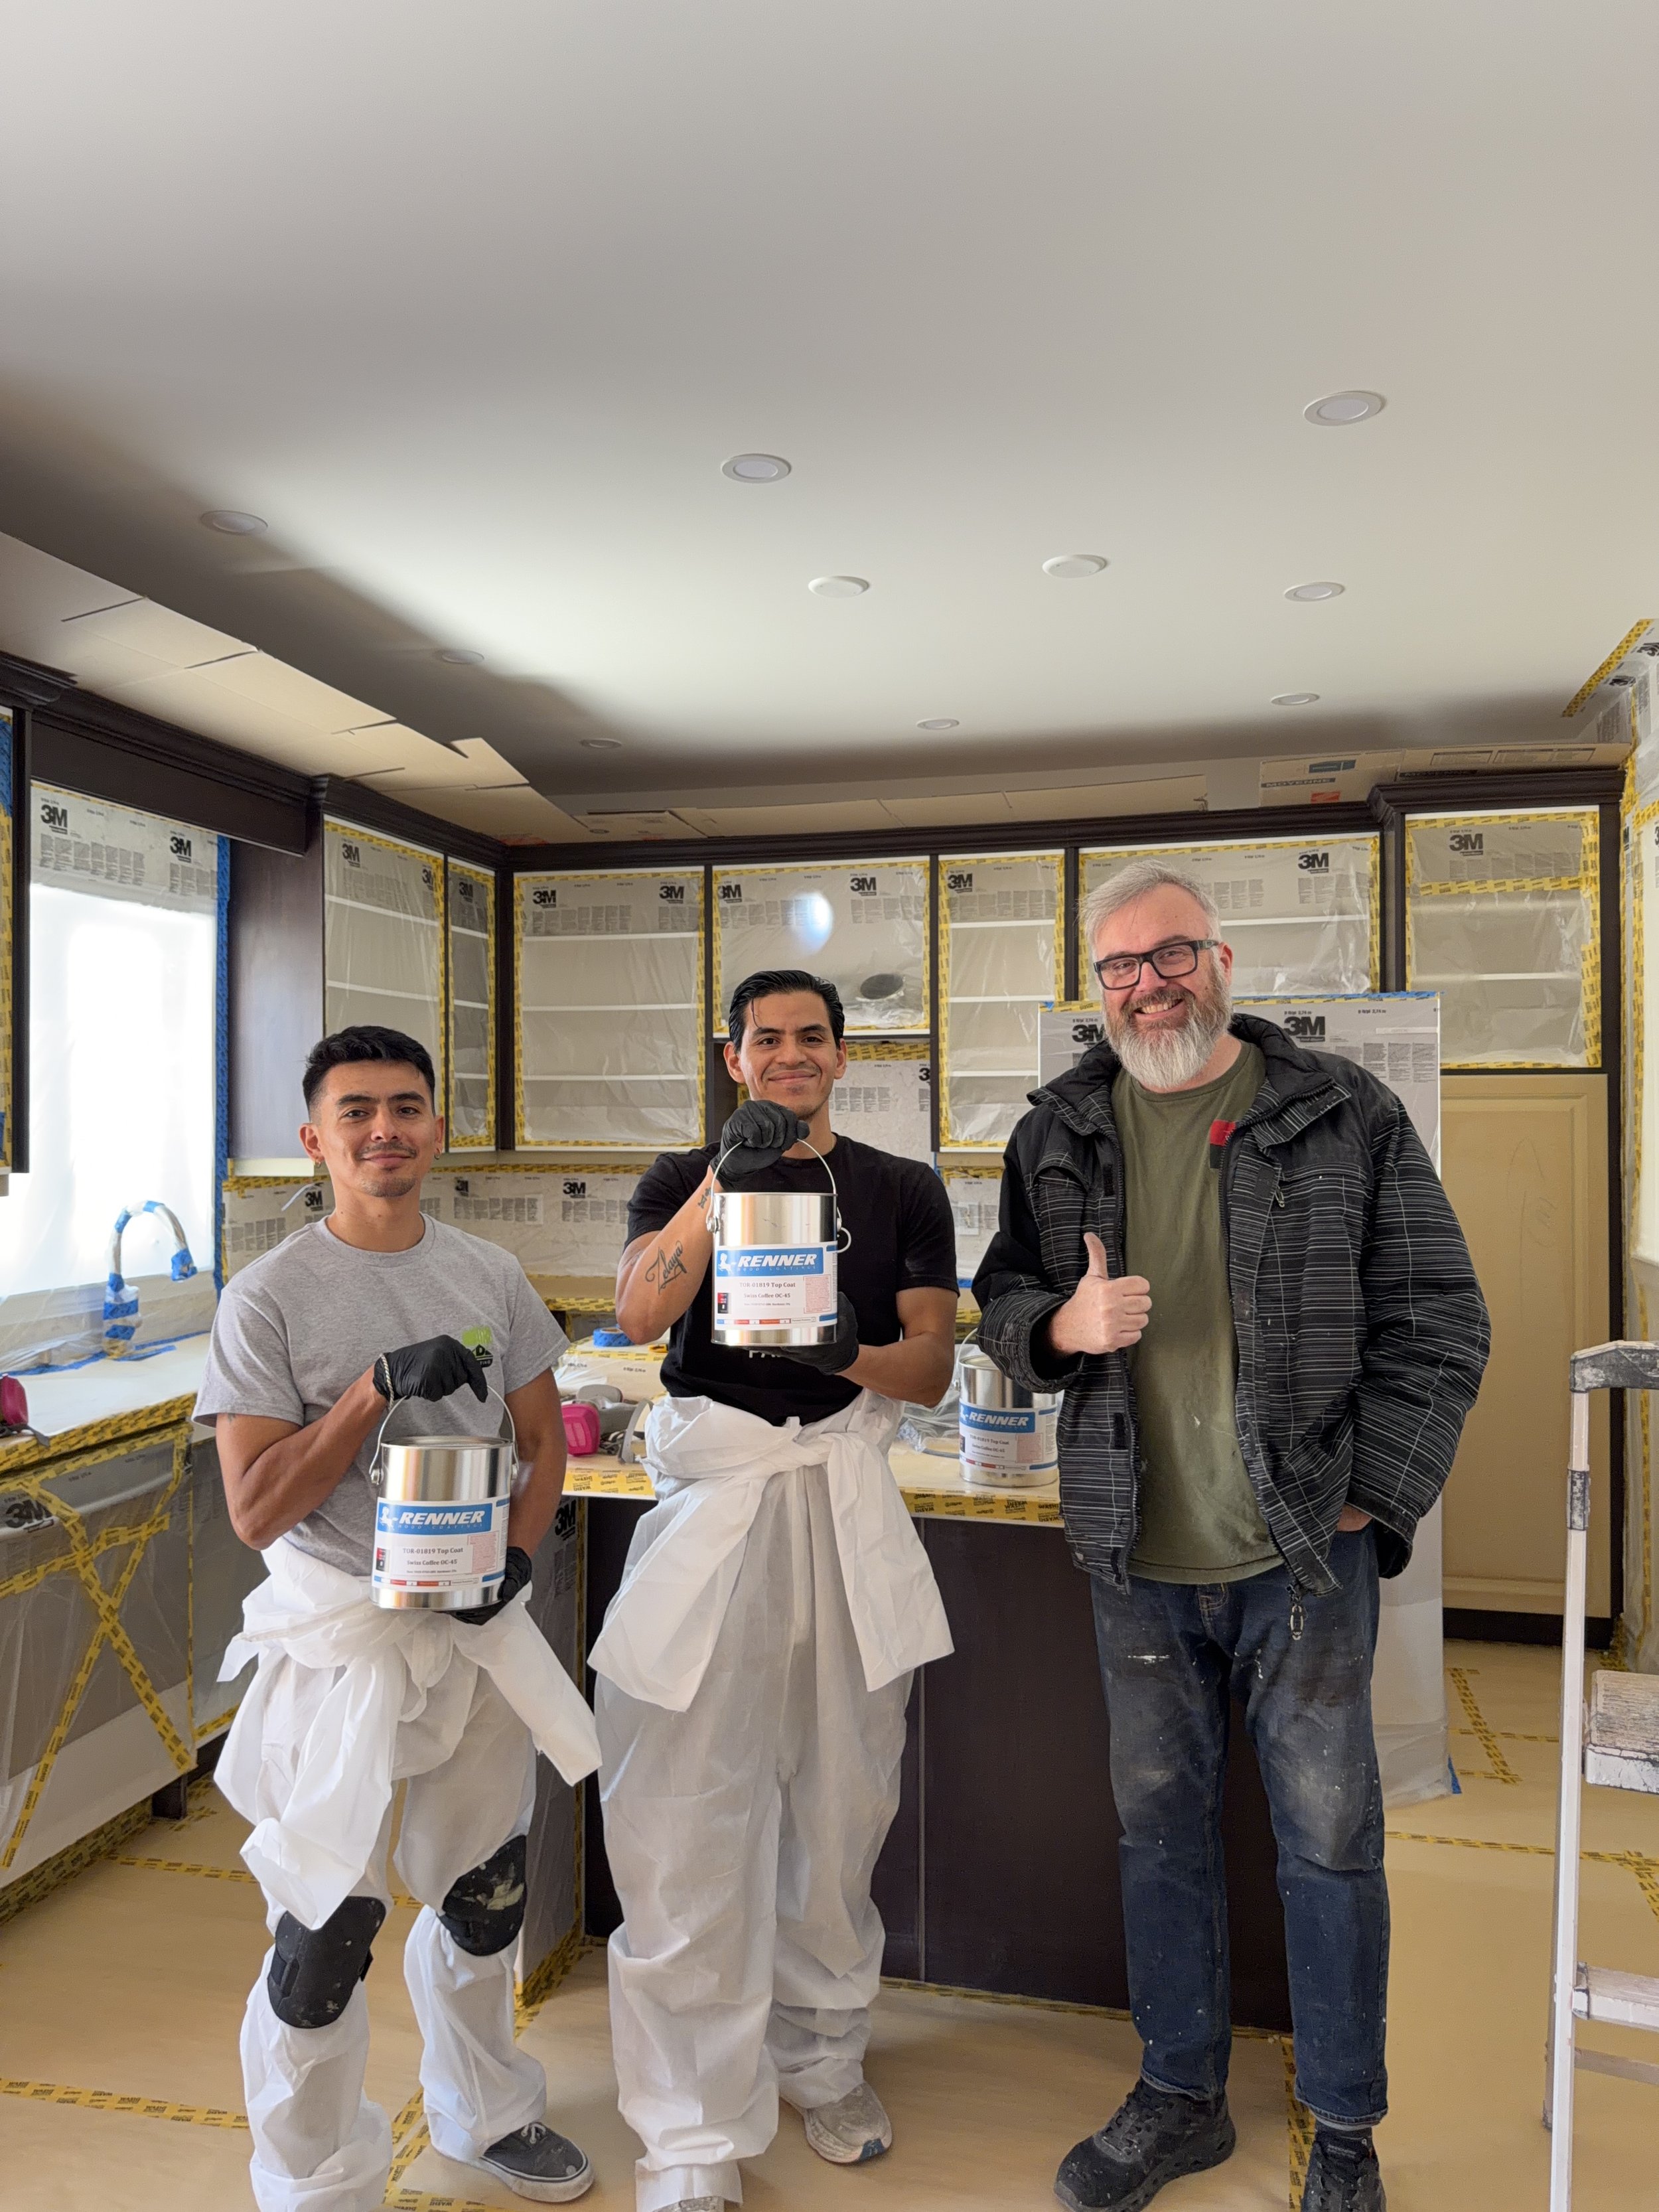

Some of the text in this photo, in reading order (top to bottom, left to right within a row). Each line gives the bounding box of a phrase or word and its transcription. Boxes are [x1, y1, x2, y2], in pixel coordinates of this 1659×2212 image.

[40, 804, 68, 828] 3M
[169, 836, 192, 857] 3M
[1449, 833, 1483, 851] 3M
[342, 844, 360, 862] 3M
[1298, 853, 1329, 869] 3M
[850, 877, 877, 893] 3M
[948, 873, 973, 889] 3M
[533, 889, 556, 905] 3M
[659, 885, 684, 900] 3M
[1283, 1016, 1326, 1035] 3M
[563, 1182, 586, 1194] 3M
[305, 1191, 323, 1207] 3M
[645, 1240, 687, 1295] Zelaya
[737, 1254, 817, 1267] RENNER
[969, 1412, 1029, 1426] RENNER
[399, 1511, 485, 1524] RENNER
[555, 1499, 576, 1536] 3M
